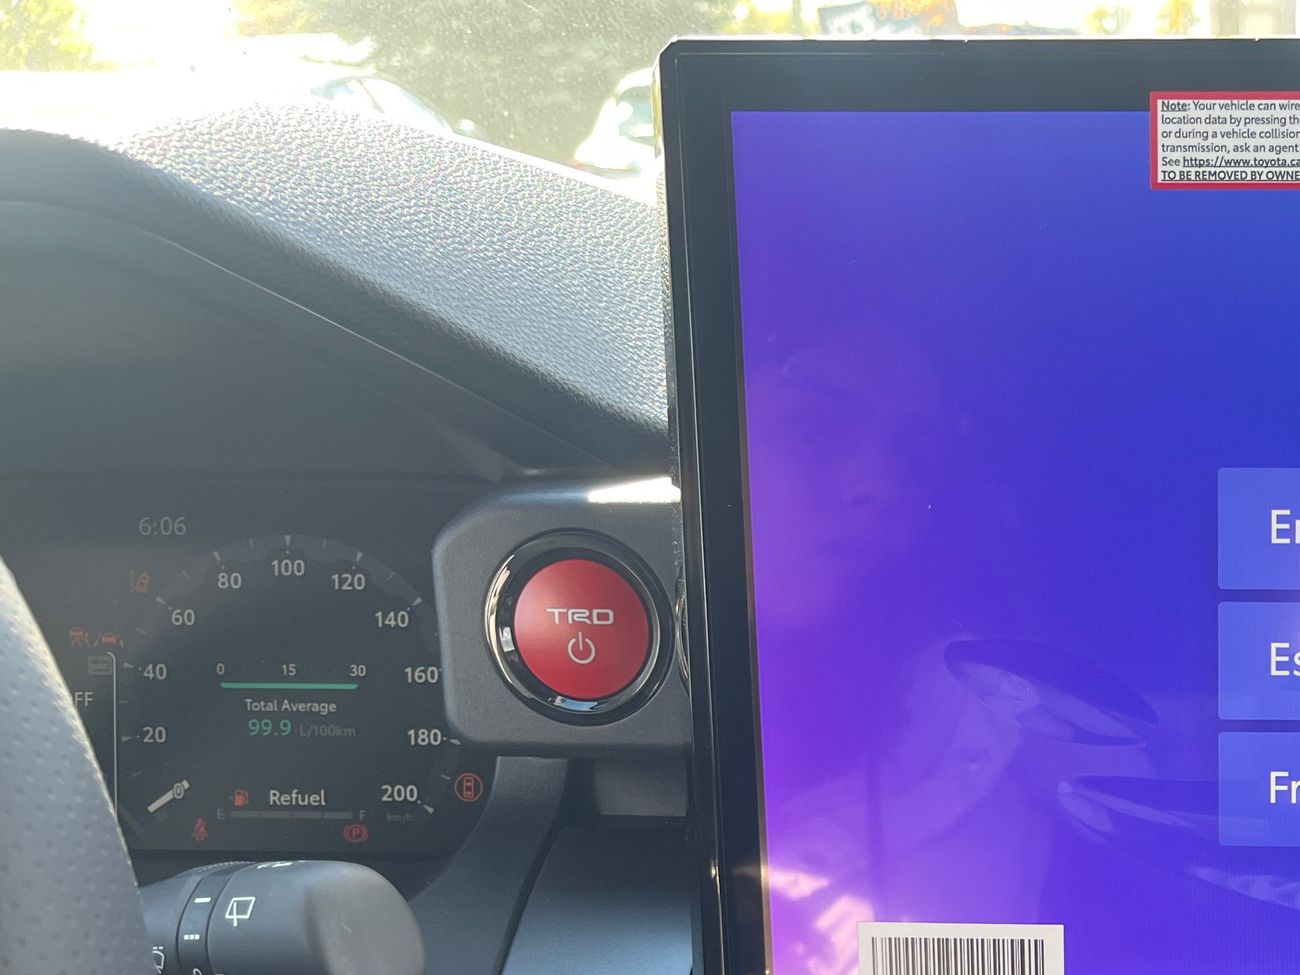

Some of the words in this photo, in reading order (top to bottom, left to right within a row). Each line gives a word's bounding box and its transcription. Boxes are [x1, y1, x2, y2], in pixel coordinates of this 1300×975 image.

[1161, 100, 1191, 112] Note:
[1193, 101, 1216, 111] Your
[1218, 100, 1255, 111] vehicle
[1257, 102, 1276, 111] can
[1161, 114, 1202, 125] location
[1204, 114, 1228, 125] data
[1229, 114, 1242, 127] by
[1244, 114, 1287, 127] pressing
[1161, 130, 1173, 139] or
[1174, 128, 1209, 141] during
[1211, 130, 1218, 139] a
[1219, 128, 1257, 139] vehicle
[1161, 142, 1231, 154] transmission,
[1232, 142, 1251, 153] ask
[1252, 144, 1266, 153] an
[1268, 143, 1300, 155] agent
[1161, 156, 1181, 167] See
[1161, 170, 1177, 182] TO
[1179, 170, 1193, 182] BE
[1194, 170, 1249, 182] REMOVED
[1250, 170, 1264, 182] BY
[138, 517, 187, 537] 6:06
[271, 560, 305, 577] 100
[217, 573, 242, 589] 80
[331, 574, 366, 591] 120
[171, 610, 195, 627] 60
[374, 611, 409, 628] 140
[545, 608, 615, 625] TRD
[142, 664, 168, 681] 40
[216, 663, 225, 676] 0
[281, 663, 297, 676] 15
[349, 664, 367, 677] 30
[404, 667, 438, 684] 160
[244, 699, 279, 712] Total
[281, 699, 337, 715] Average
[142, 726, 167, 743] 20
[248, 719, 292, 736] 99.9
[407, 729, 441, 745] 180
[173, 782, 185, 799] 0
[269, 790, 326, 806] Refuel
[381, 784, 418, 802] 200
